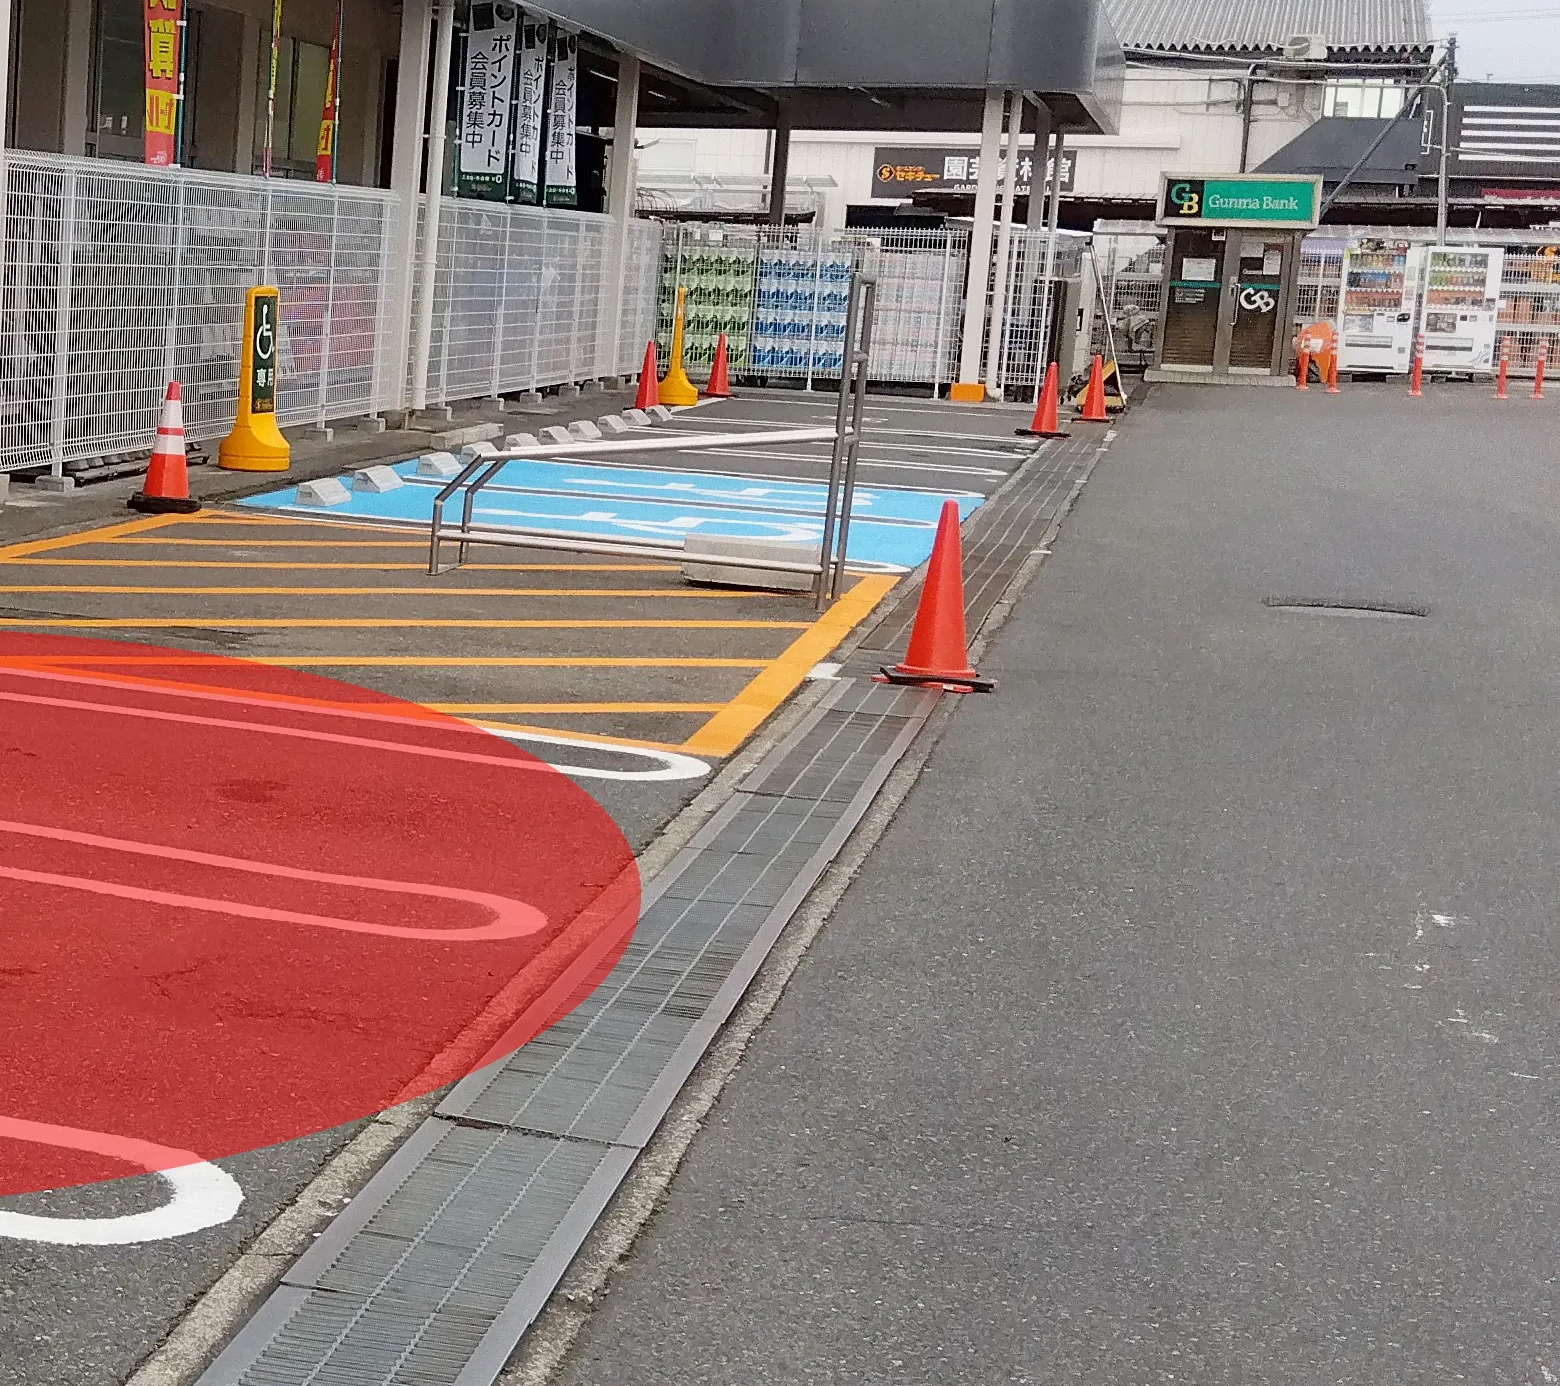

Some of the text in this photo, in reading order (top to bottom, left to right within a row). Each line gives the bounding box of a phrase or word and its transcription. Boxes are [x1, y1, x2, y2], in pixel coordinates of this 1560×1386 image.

[465, 51, 489, 150] 会員募集中
[487, 34, 512, 168] ポイントカード
[549, 79, 568, 165] 会員募集中
[1208, 194, 1299, 211] Gunma Bank
